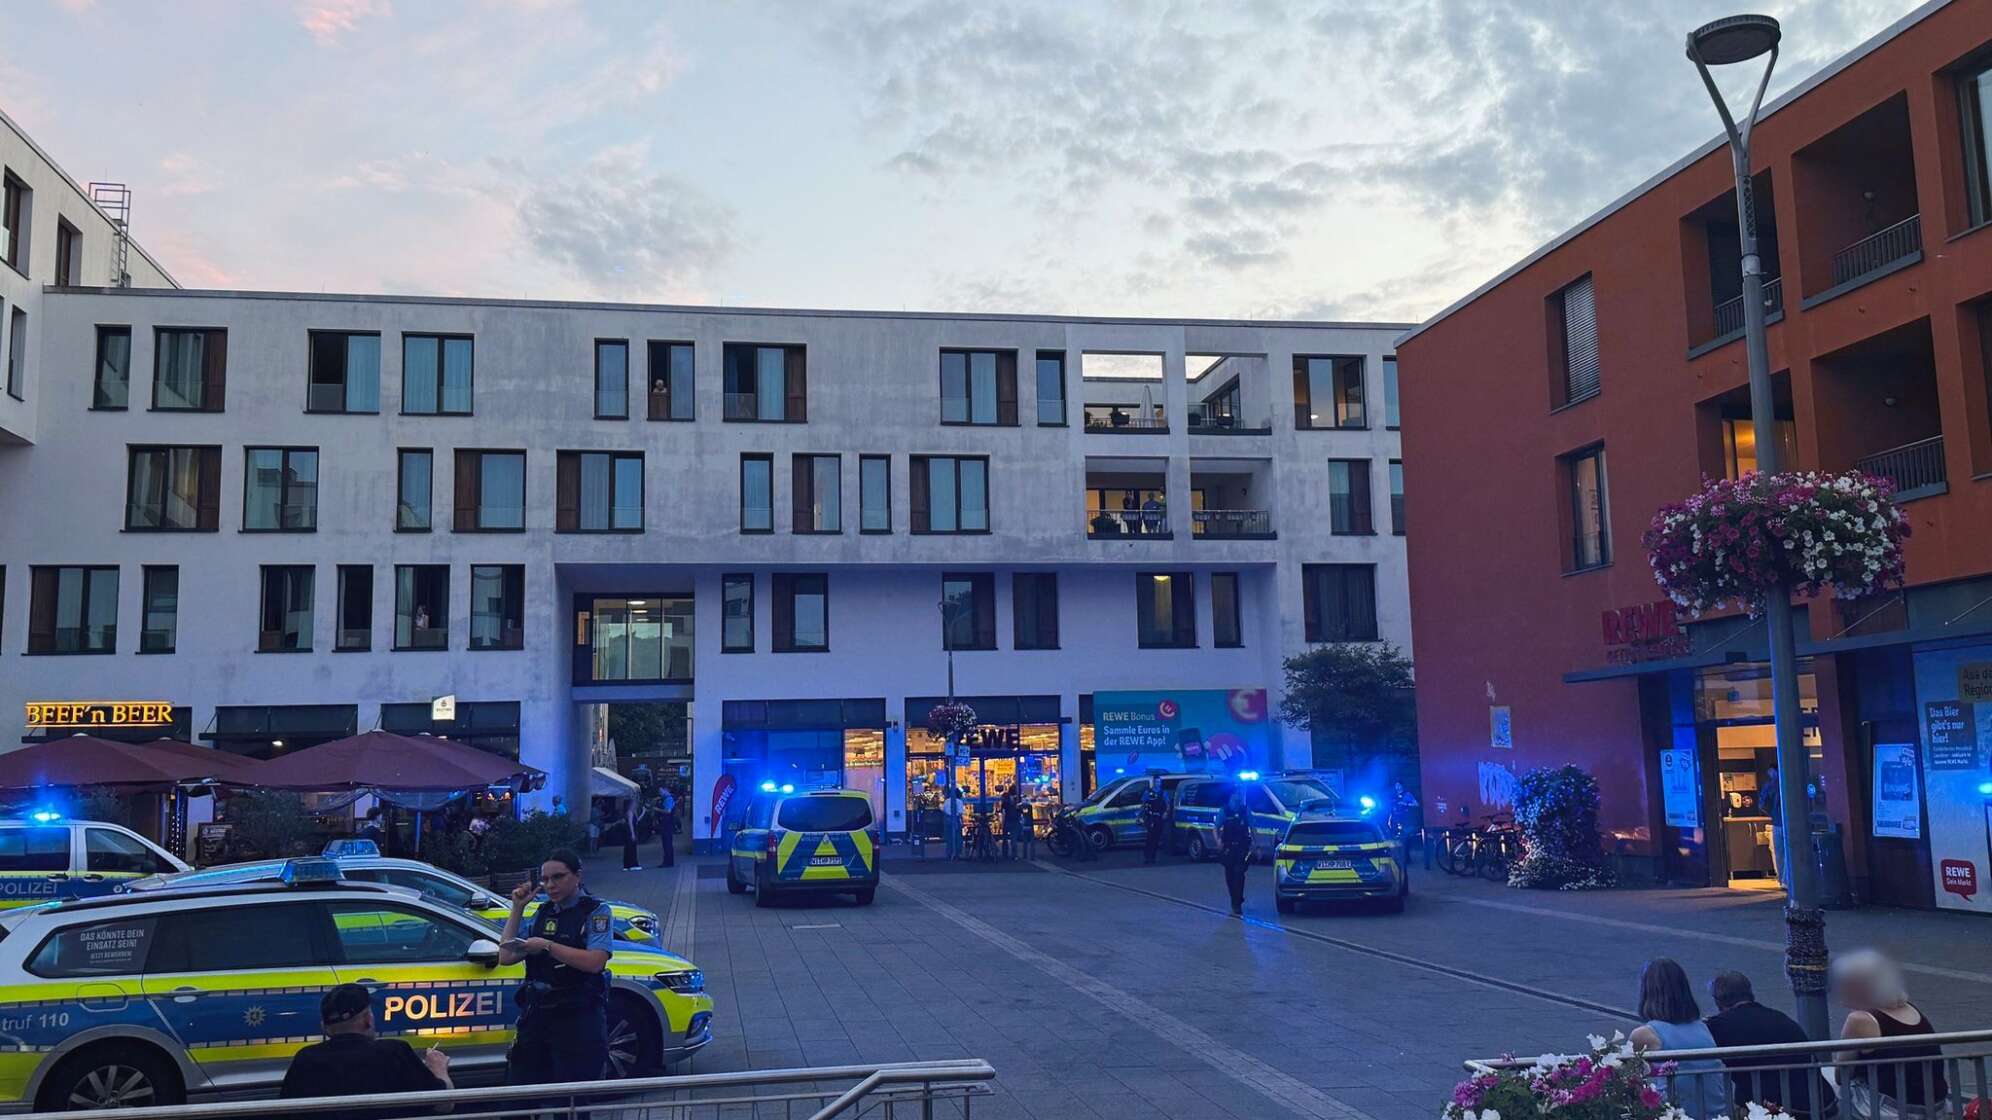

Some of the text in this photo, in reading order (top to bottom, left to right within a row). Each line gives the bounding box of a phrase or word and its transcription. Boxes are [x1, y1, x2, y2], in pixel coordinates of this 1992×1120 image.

[26, 704, 173, 724] BEEF'n BEER
[1103, 711, 1156, 721] REWE Bonus
[1929, 705, 1960, 718] Das Bier
[1103, 724, 1170, 736] Sammle Euros in
[1104, 736, 1167, 747] der REWE App!
[714, 783, 735, 815] REWE
[1945, 866, 1971, 878] REWE
[80, 928, 144, 941] DAS KÖNNTE DEIN
[86, 940, 116, 951] EINSATZ
[384, 991, 502, 1021] POLIZEI
[40, 1012, 69, 1028] 110
